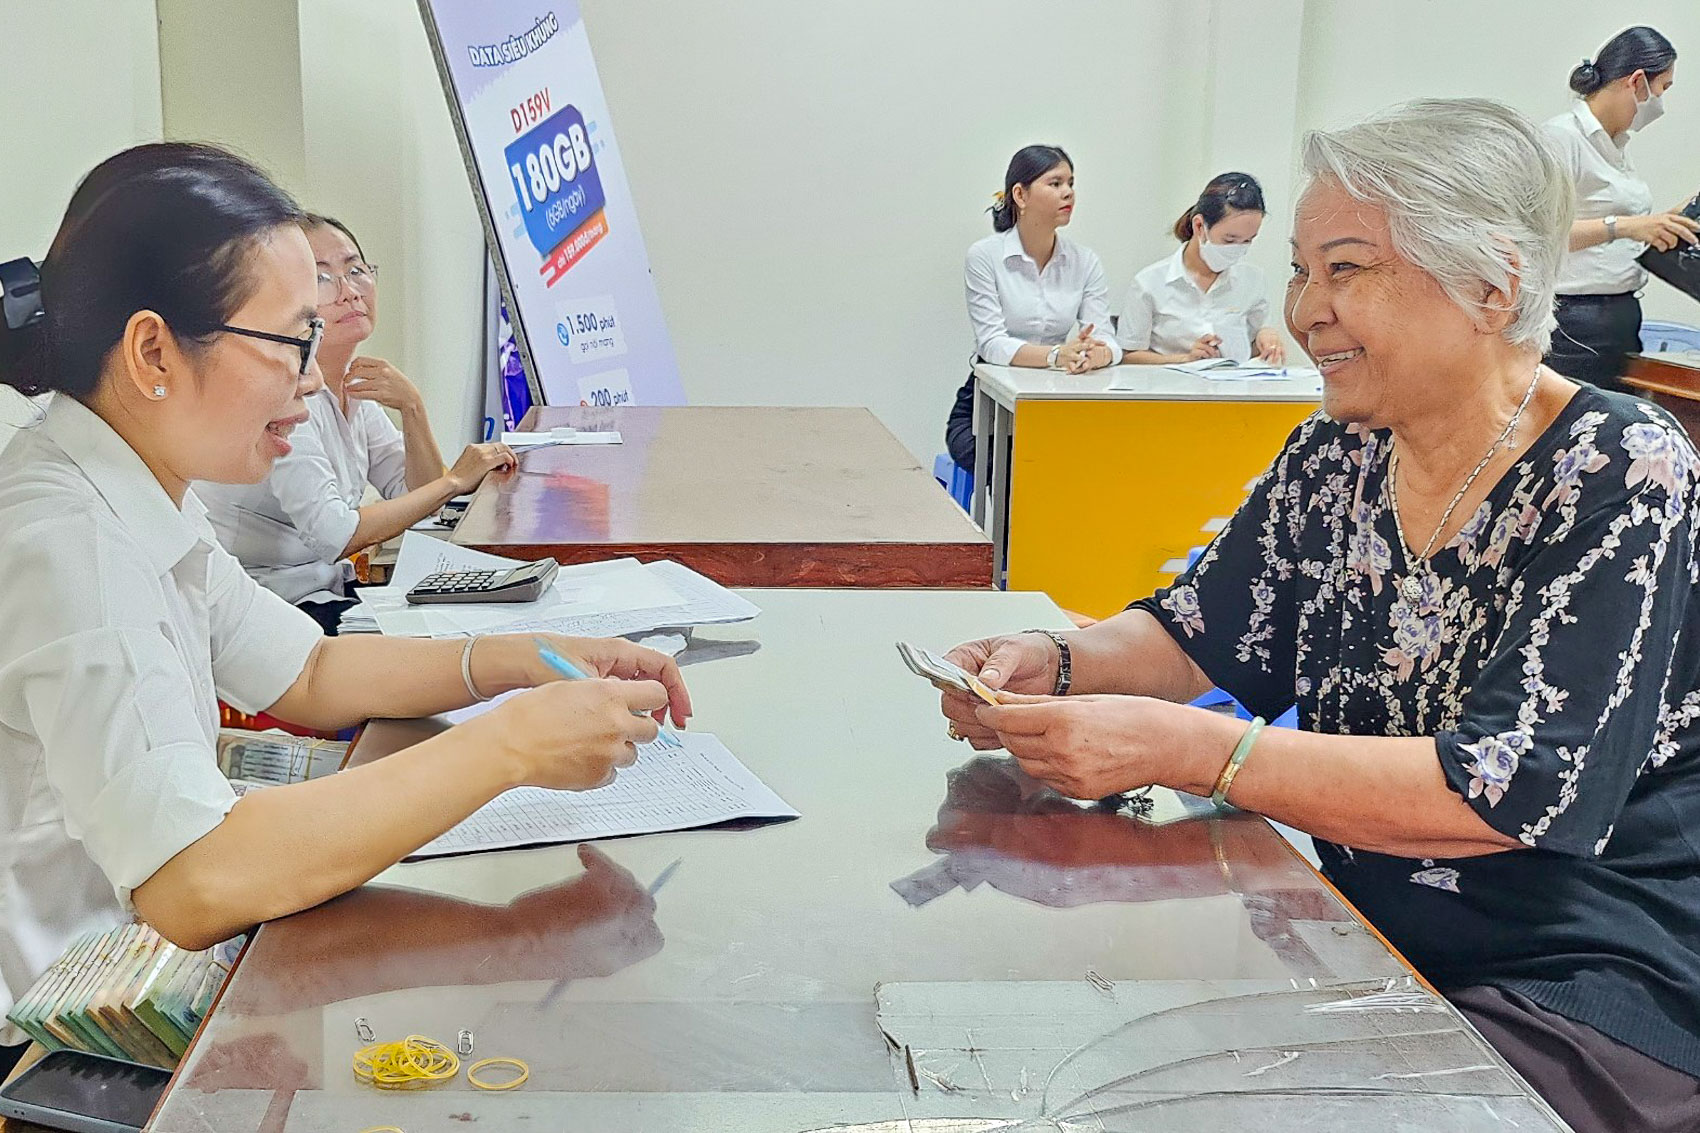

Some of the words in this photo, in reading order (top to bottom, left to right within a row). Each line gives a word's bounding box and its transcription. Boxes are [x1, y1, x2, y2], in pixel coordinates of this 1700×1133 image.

[468, 46, 504, 67] DATA
[501, 35, 528, 63] SIÊU
[510, 87, 552, 133] D159V
[511, 122, 592, 212] 180GB
[566, 312, 598, 335] 1.500
[590, 388, 612, 406] 200
